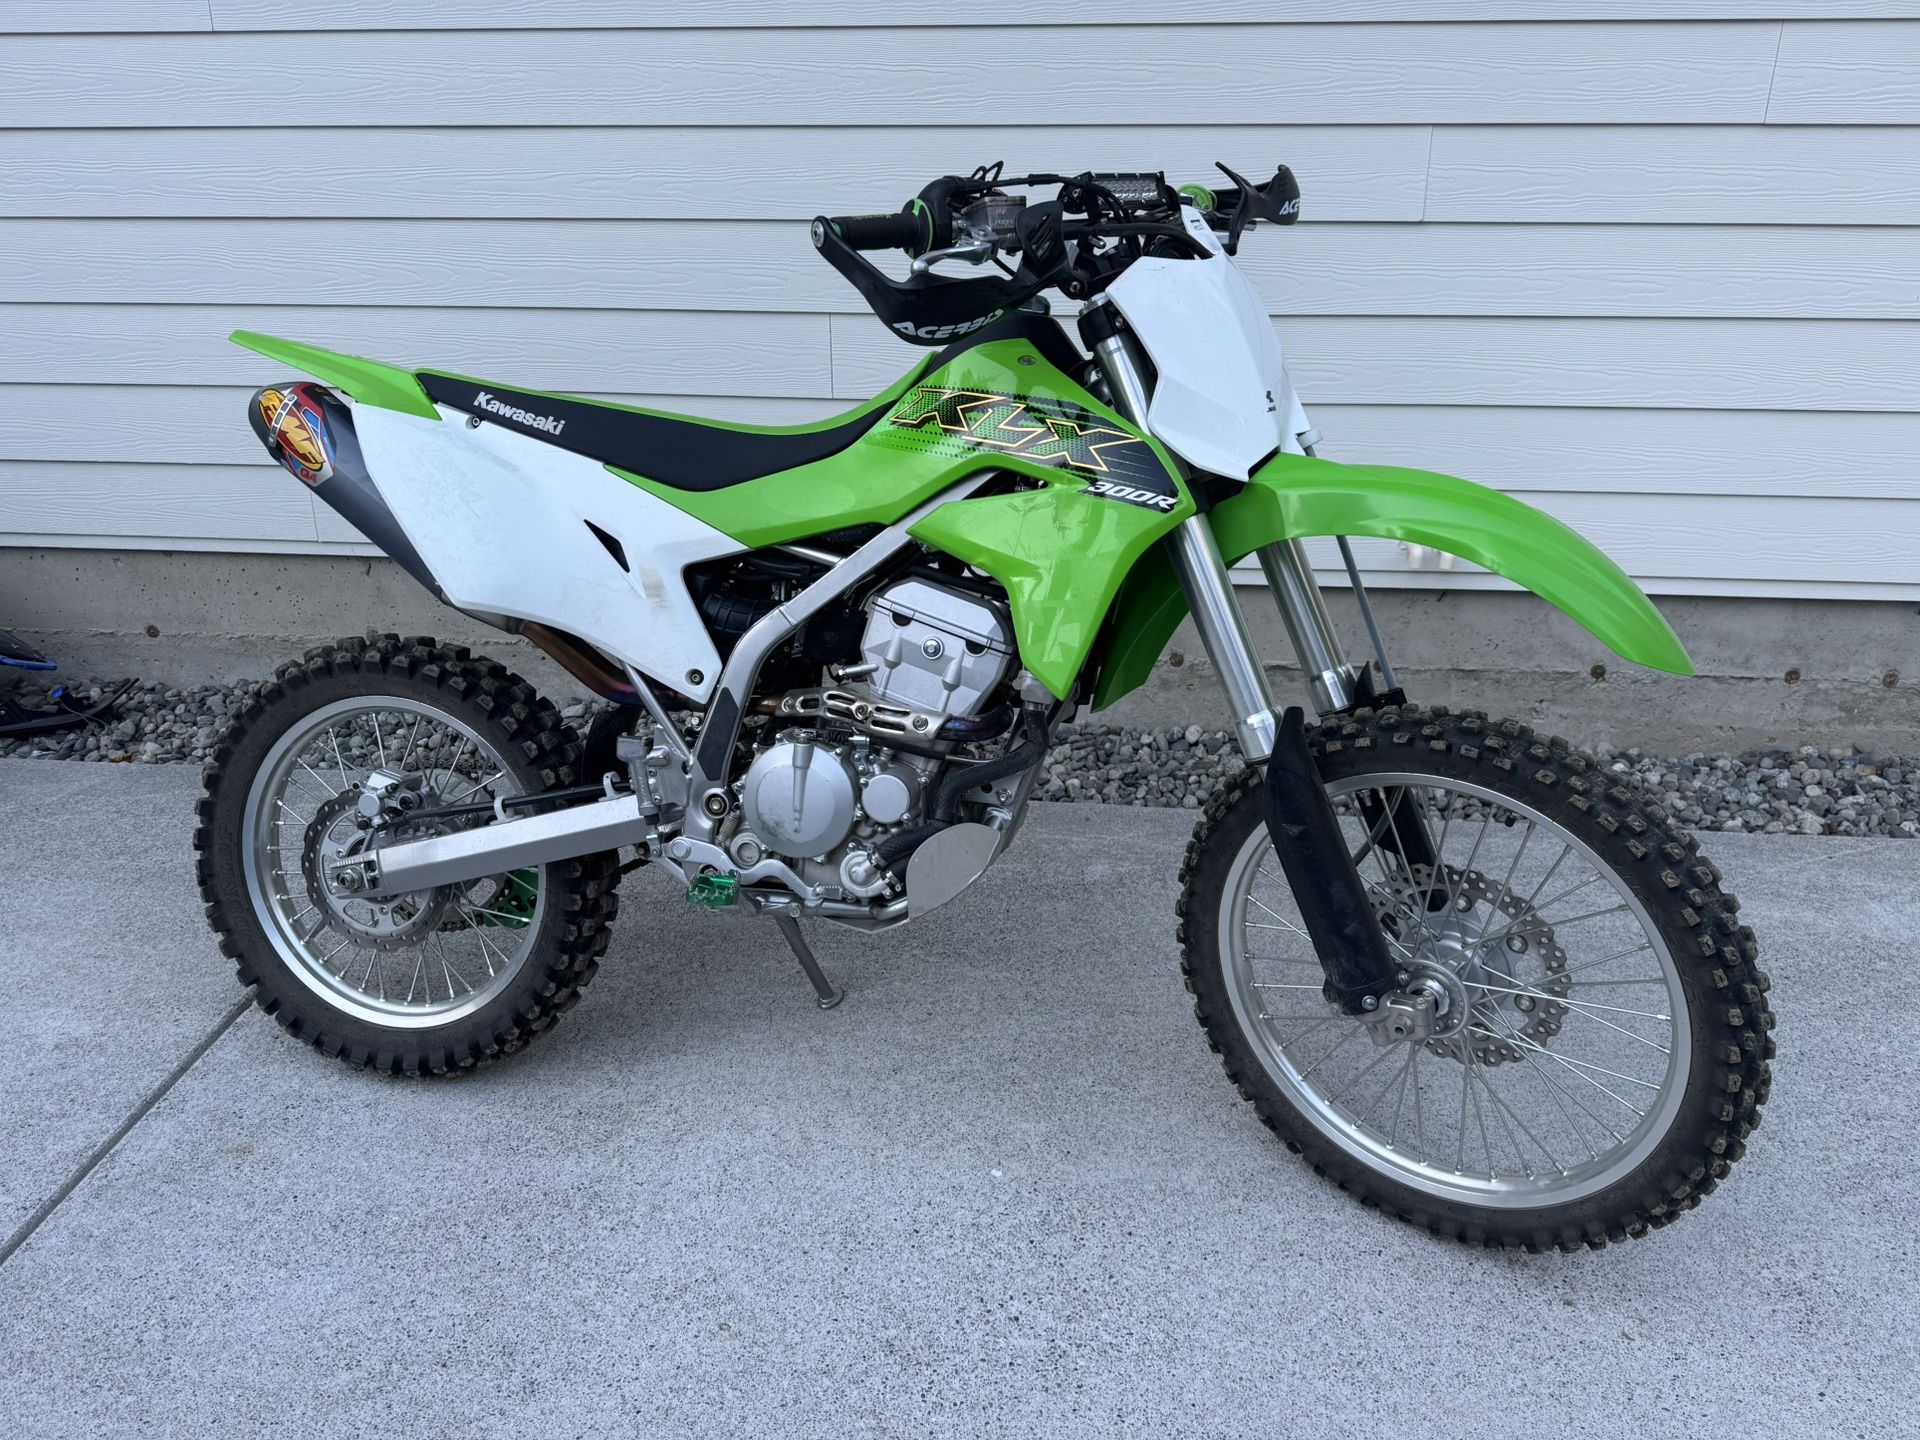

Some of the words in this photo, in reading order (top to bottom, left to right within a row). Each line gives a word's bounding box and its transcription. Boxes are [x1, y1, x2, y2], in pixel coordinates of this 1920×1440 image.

[473, 391, 566, 436] Kawasaki
[889, 387, 1144, 472] KLX
[1087, 481, 1178, 510] 300R
